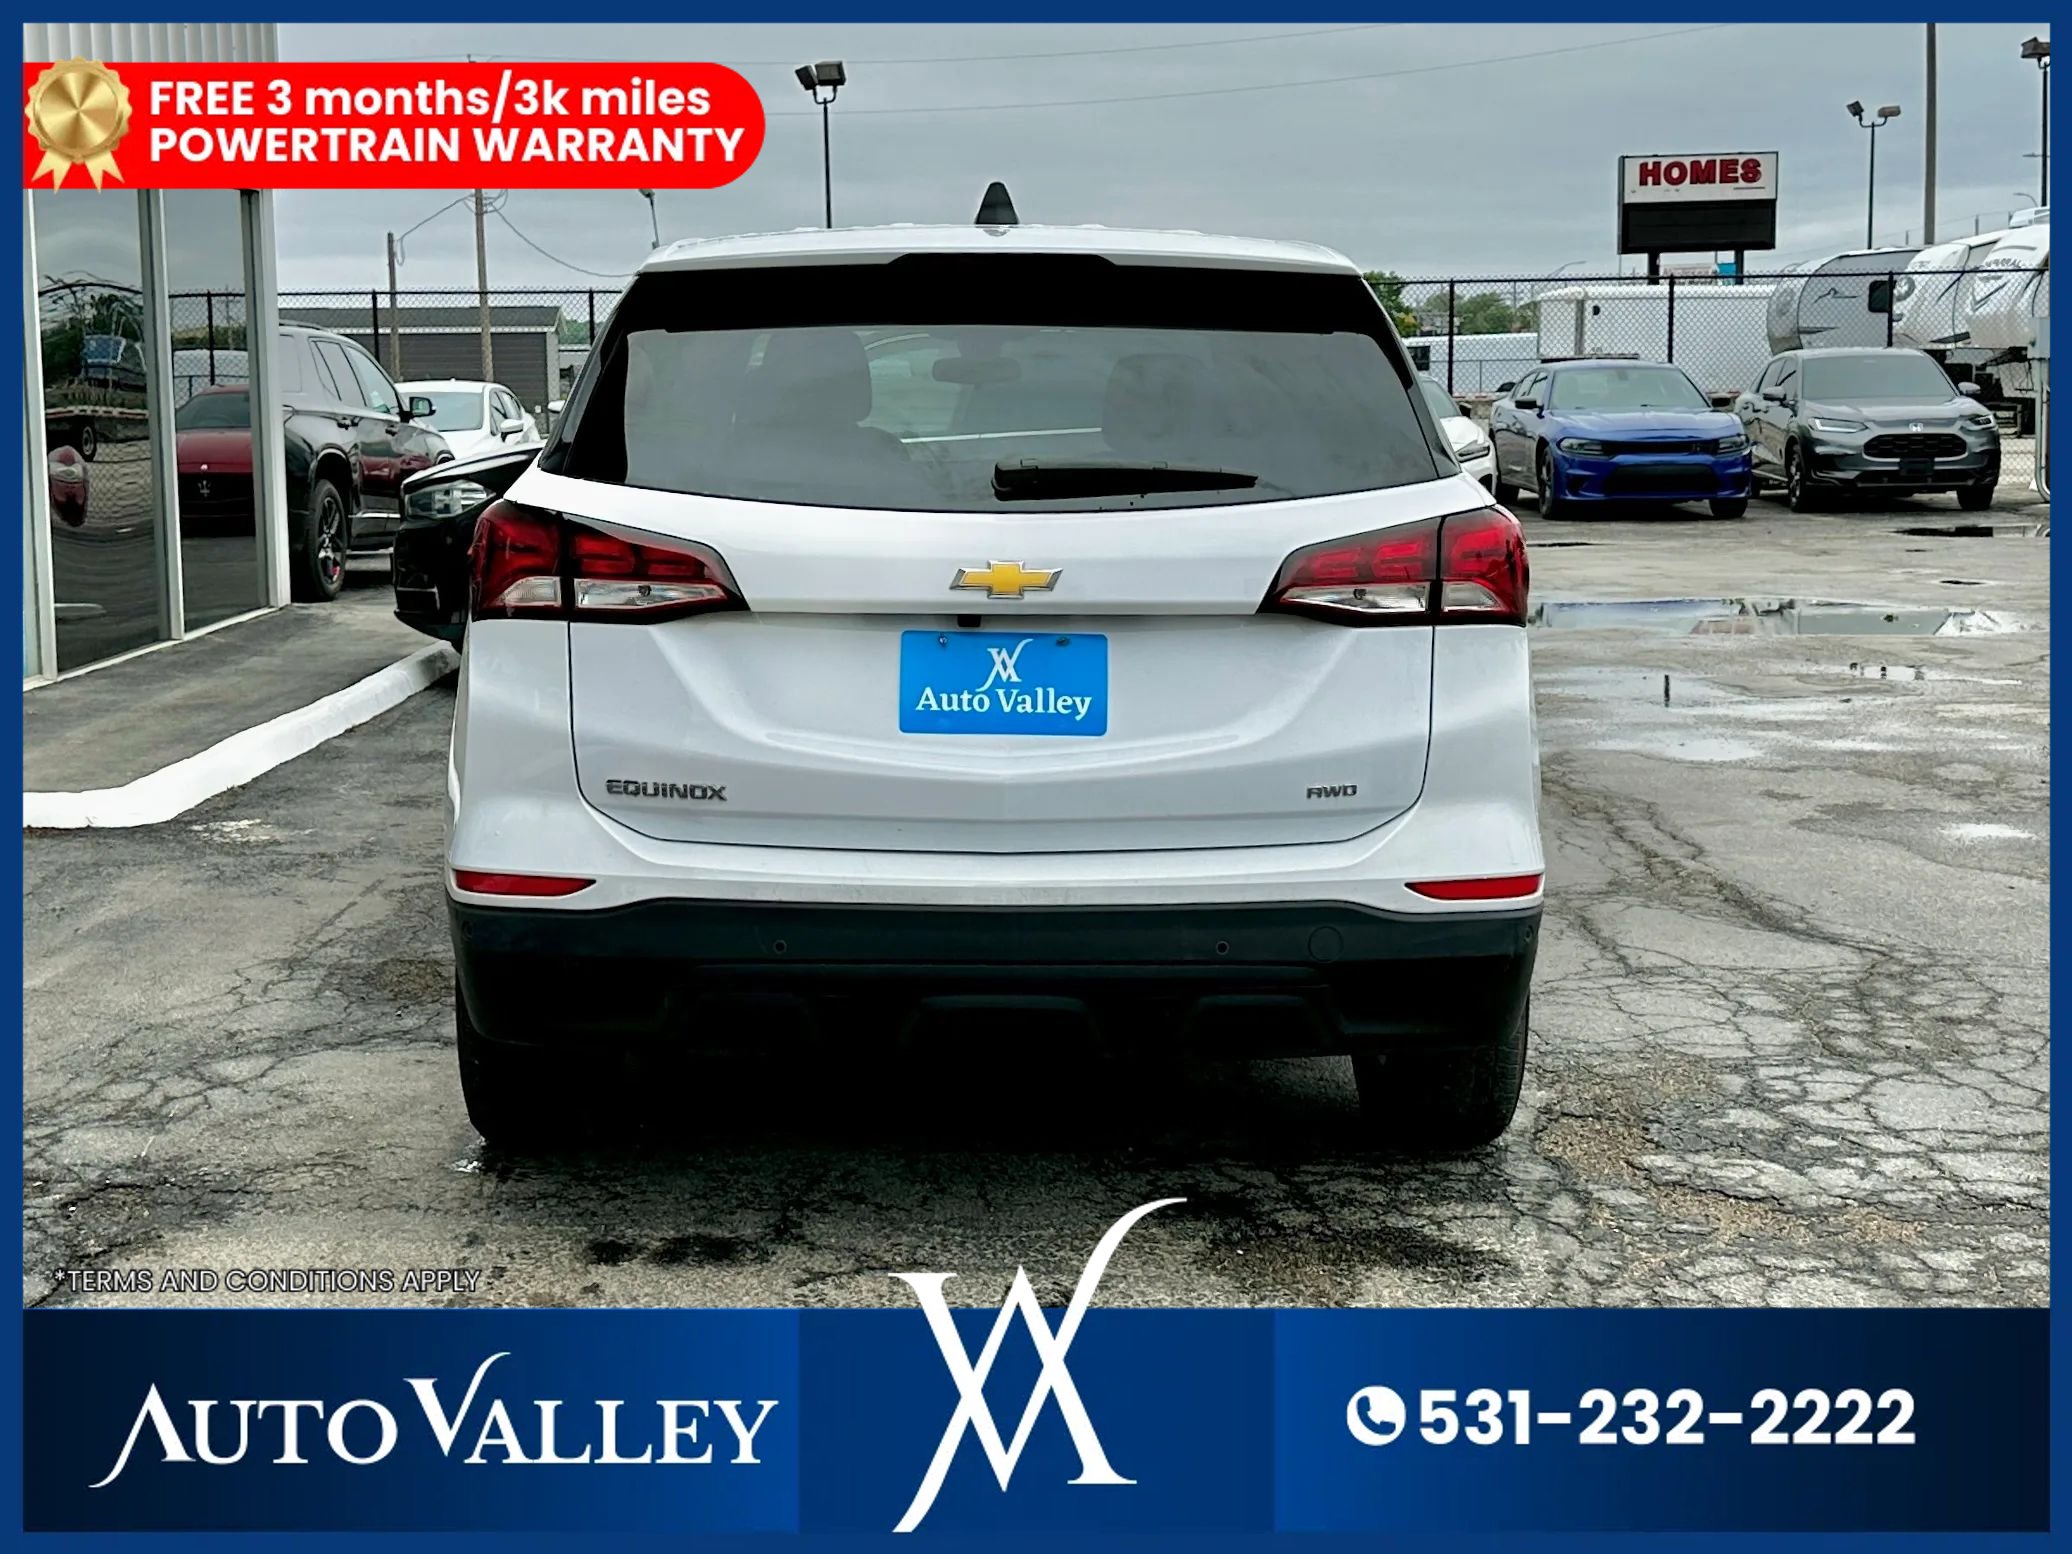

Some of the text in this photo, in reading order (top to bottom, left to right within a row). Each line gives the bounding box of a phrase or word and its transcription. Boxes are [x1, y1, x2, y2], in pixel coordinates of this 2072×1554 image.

[1639, 158, 1761, 186] HOMES
[915, 686, 1093, 721] Auto Valley
[605, 779, 729, 802] EQUINOX
[1305, 783, 1359, 800] AWD
